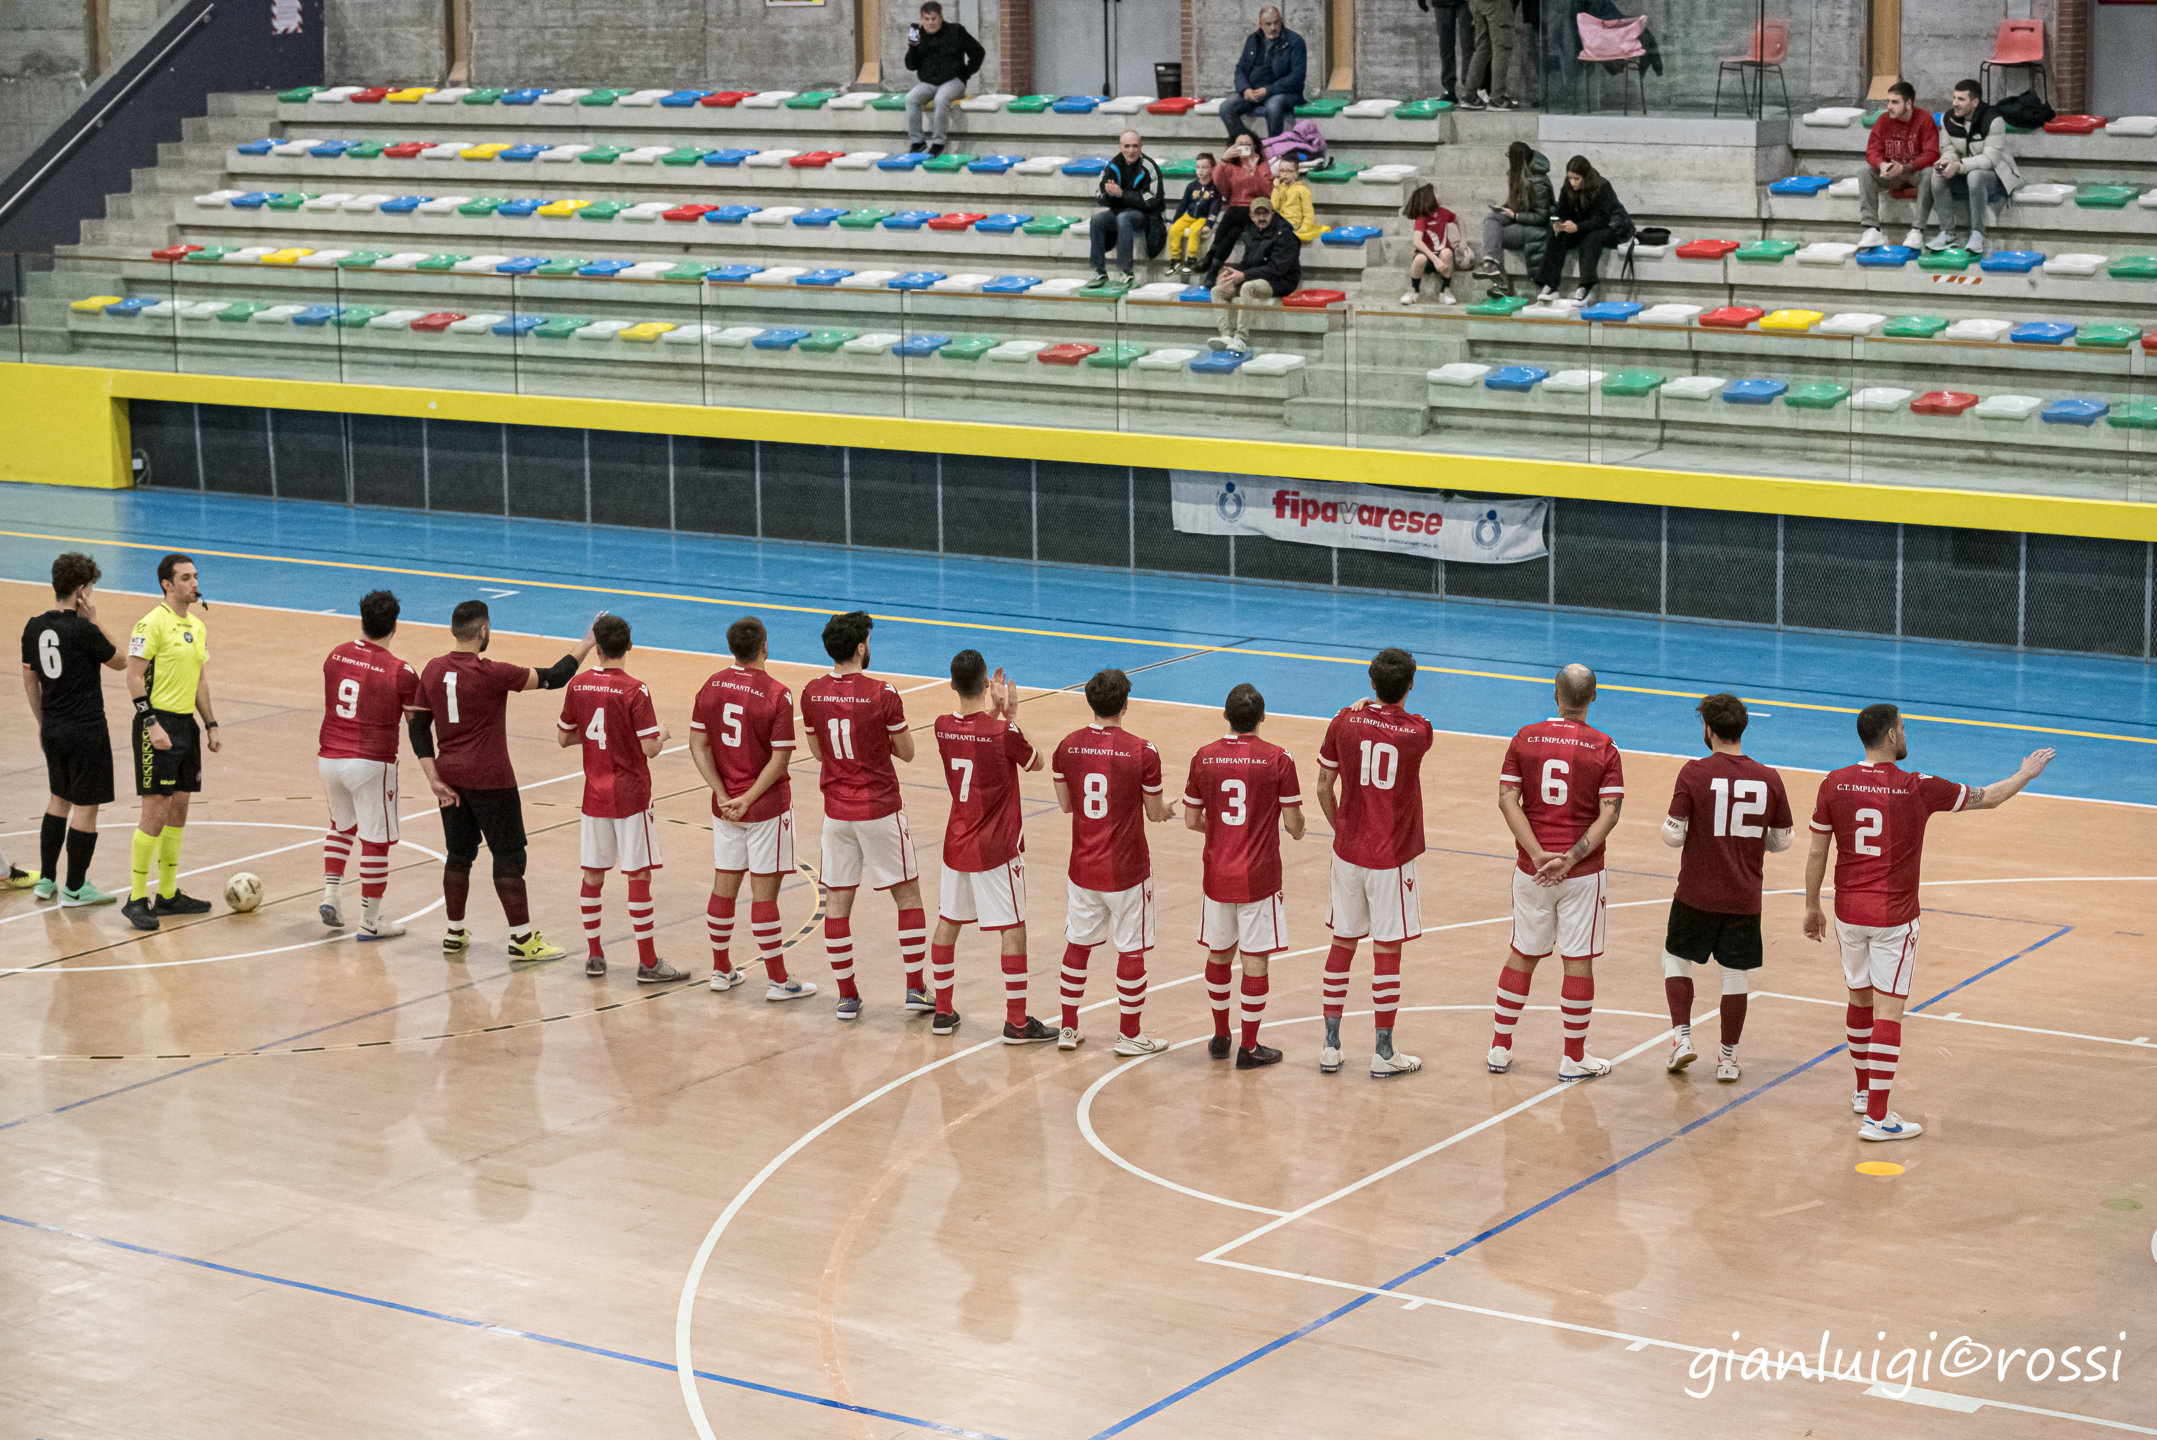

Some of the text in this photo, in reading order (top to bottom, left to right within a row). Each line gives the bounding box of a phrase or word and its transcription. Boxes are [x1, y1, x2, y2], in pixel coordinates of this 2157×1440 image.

[1272, 489, 1443, 535] fipavarese
[1350, 533, 1386, 543] COMITATO
[38, 629, 63, 679] 6
[342, 656, 371, 670] IMPIANTI
[336, 678, 360, 719] 9
[443, 671, 460, 723] 1
[582, 684, 610, 693] IMPIANTI
[721, 682, 751, 693] IMPIANTI
[585, 707, 607, 750] 4
[721, 702, 744, 748] 5
[828, 718, 855, 760] 11
[945, 732, 976, 742] IMPIANTI
[1363, 718, 1398, 731] IMPIANTI
[1541, 736, 1579, 746] IMPIANTI
[1081, 748, 1114, 756] IMPIANTI
[1360, 740, 1399, 790] 10
[951, 758, 974, 802] 7
[1083, 773, 1108, 819] 8
[1541, 759, 1570, 806] 6
[1852, 784, 1890, 794] IMPIANTI
[1221, 779, 1247, 826] 3
[1710, 777, 1768, 839] 12
[1855, 808, 1883, 857] 2
